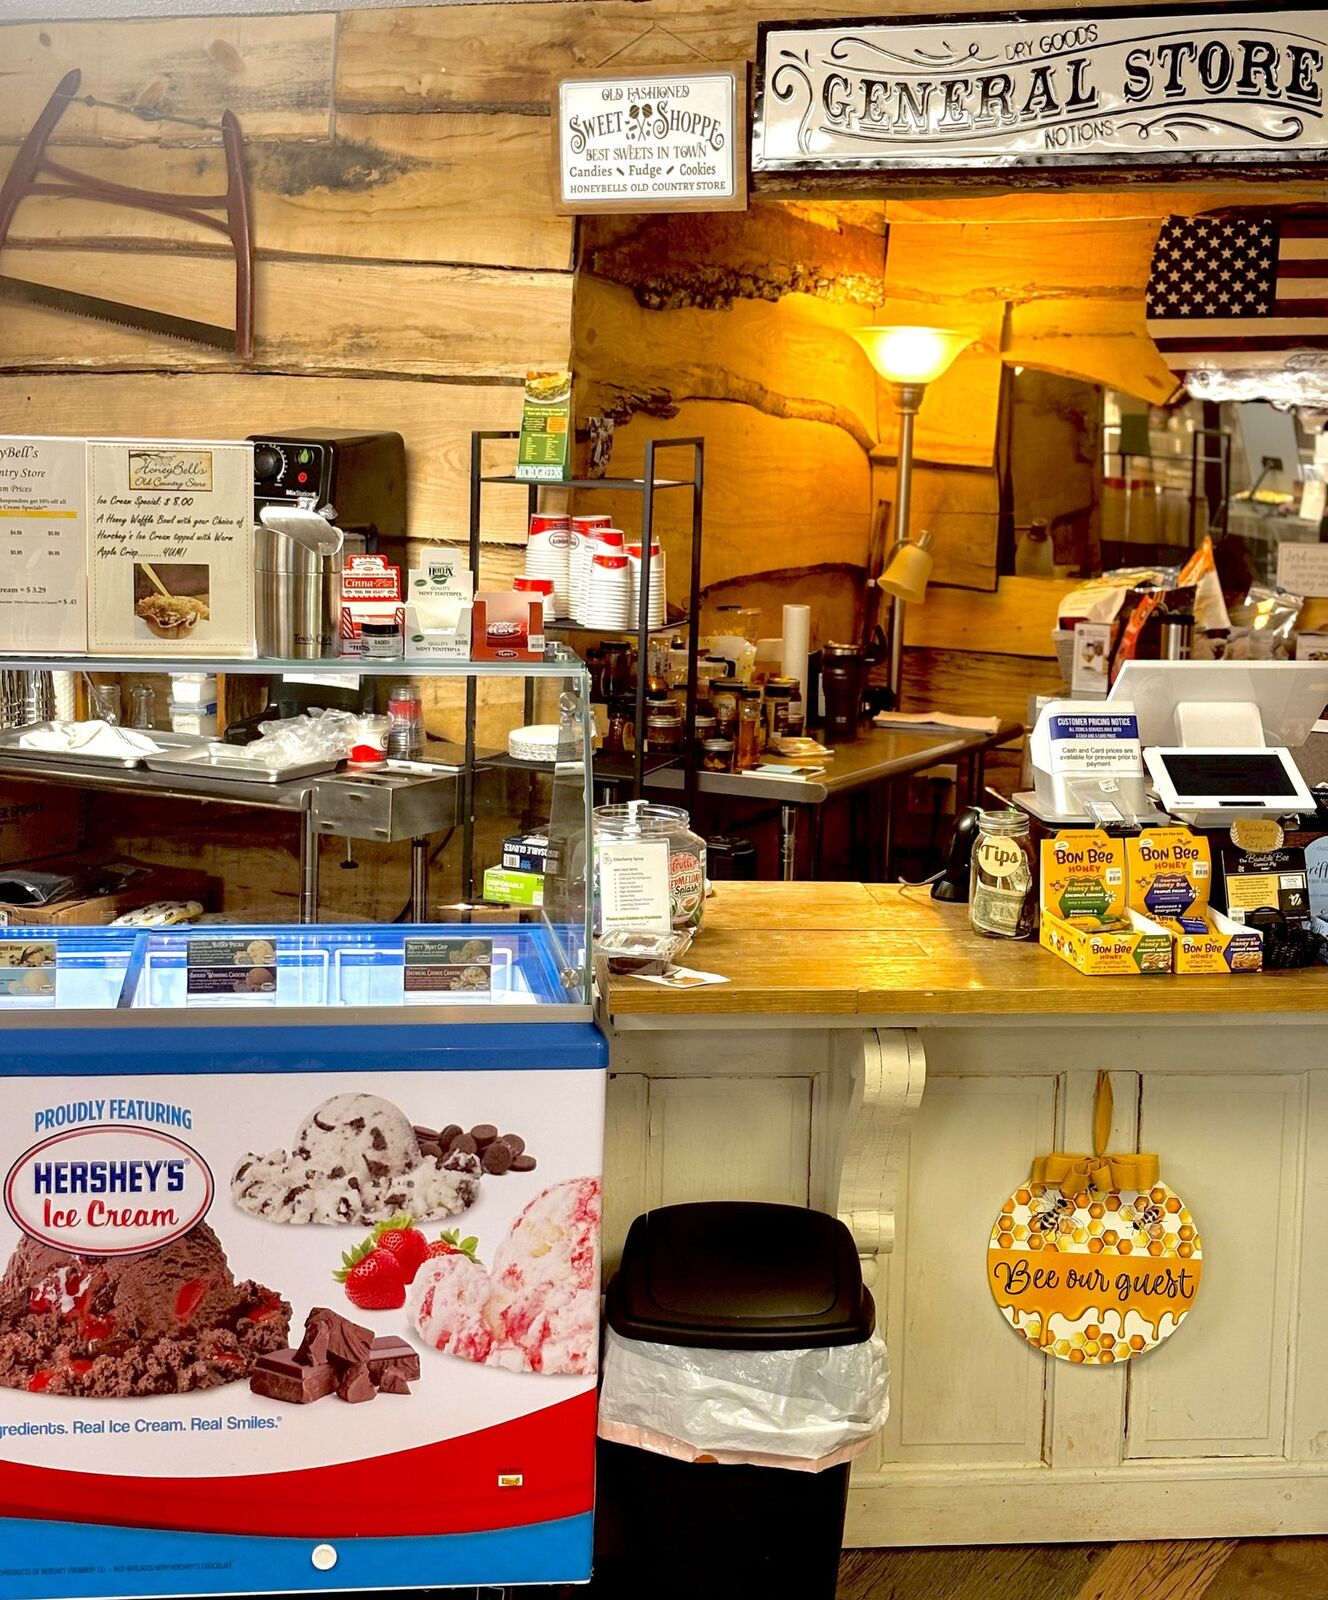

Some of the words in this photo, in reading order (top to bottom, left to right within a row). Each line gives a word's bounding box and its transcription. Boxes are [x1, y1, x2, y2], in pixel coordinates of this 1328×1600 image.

[1005, 40, 1035, 62] DRY
[1039, 24, 1098, 52] GOODS
[821, 58, 1099, 134] GENERAL
[1121, 38, 1326, 104] STORE
[601, 88, 623, 101] OLD
[627, 85, 690, 103] FASHIONED
[569, 111, 624, 154] SWEET
[652, 100, 725, 152] SHOPPE
[1044, 119, 1114, 151] NOTIONS
[585, 148, 610, 162] BEST
[613, 144, 654, 161] SWEETS
[657, 146, 670, 159] IN
[673, 142, 707, 158] TOWN
[569, 165, 612, 178] Candies
[628, 163, 662, 178] Fudge
[679, 162, 716, 176] Cookies
[570, 184, 628, 193] HONEYBELLS
[630, 183, 649, 192] OLD
[652, 182, 695, 192] COUNTRY
[696, 181, 726, 190] STORE
[20, 468, 46, 478] Store
[135, 460, 208, 479] HoneyBell's
[514, 466, 563, 479] MICROGREENS
[134, 477, 153, 486] Old
[153, 477, 184, 490] Country
[185, 478, 206, 487] Store
[97, 496, 107, 504] Ice
[110, 496, 131, 505] Cream
[173, 497, 194, 506] 8.00
[96, 514, 104, 523] A
[106, 514, 127, 527] Honey
[130, 515, 154, 527] Waffle
[157, 515, 176, 524] Bowl
[177, 516, 191, 524] with
[194, 518, 209, 528] your
[212, 516, 234, 525] Choice
[236, 517, 245, 528] of
[97, 530, 133, 543] Hershey's
[136, 531, 146, 540] Ice
[149, 531, 170, 541] Cream
[173, 533, 194, 544] topped
[196, 533, 211, 541] with
[214, 533, 233, 542] Warm
[97, 547, 117, 559] Apple
[1058, 718, 1087, 726] CUSTOMER
[1088, 718, 1110, 726] PRICING
[1111, 718, 1131, 726] NOTICE
[1105, 748, 1123, 756] prices
[1117, 754, 1131, 762] prior
[981, 844, 1019, 867] Tips
[1273, 852, 1290, 861] Bee
[1068, 864, 1101, 873] HONEY
[1154, 861, 1187, 870] HONEY
[674, 884, 698, 896] Splash
[34, 1099, 105, 1133] PROUDLY
[109, 1099, 193, 1130] FEATURING
[34, 1160, 184, 1194] HERSHEY'S
[43, 1198, 82, 1228] Ice
[87, 1199, 179, 1228] Cream
[994, 1259, 1060, 1295] Bee
[1066, 1268, 1110, 1293] our
[1115, 1268, 1195, 1301] guest
[72, 1420, 105, 1434] Real
[109, 1419, 130, 1433] Ice
[134, 1418, 187, 1432] Cream.
[190, 1416, 223, 1431] Real
